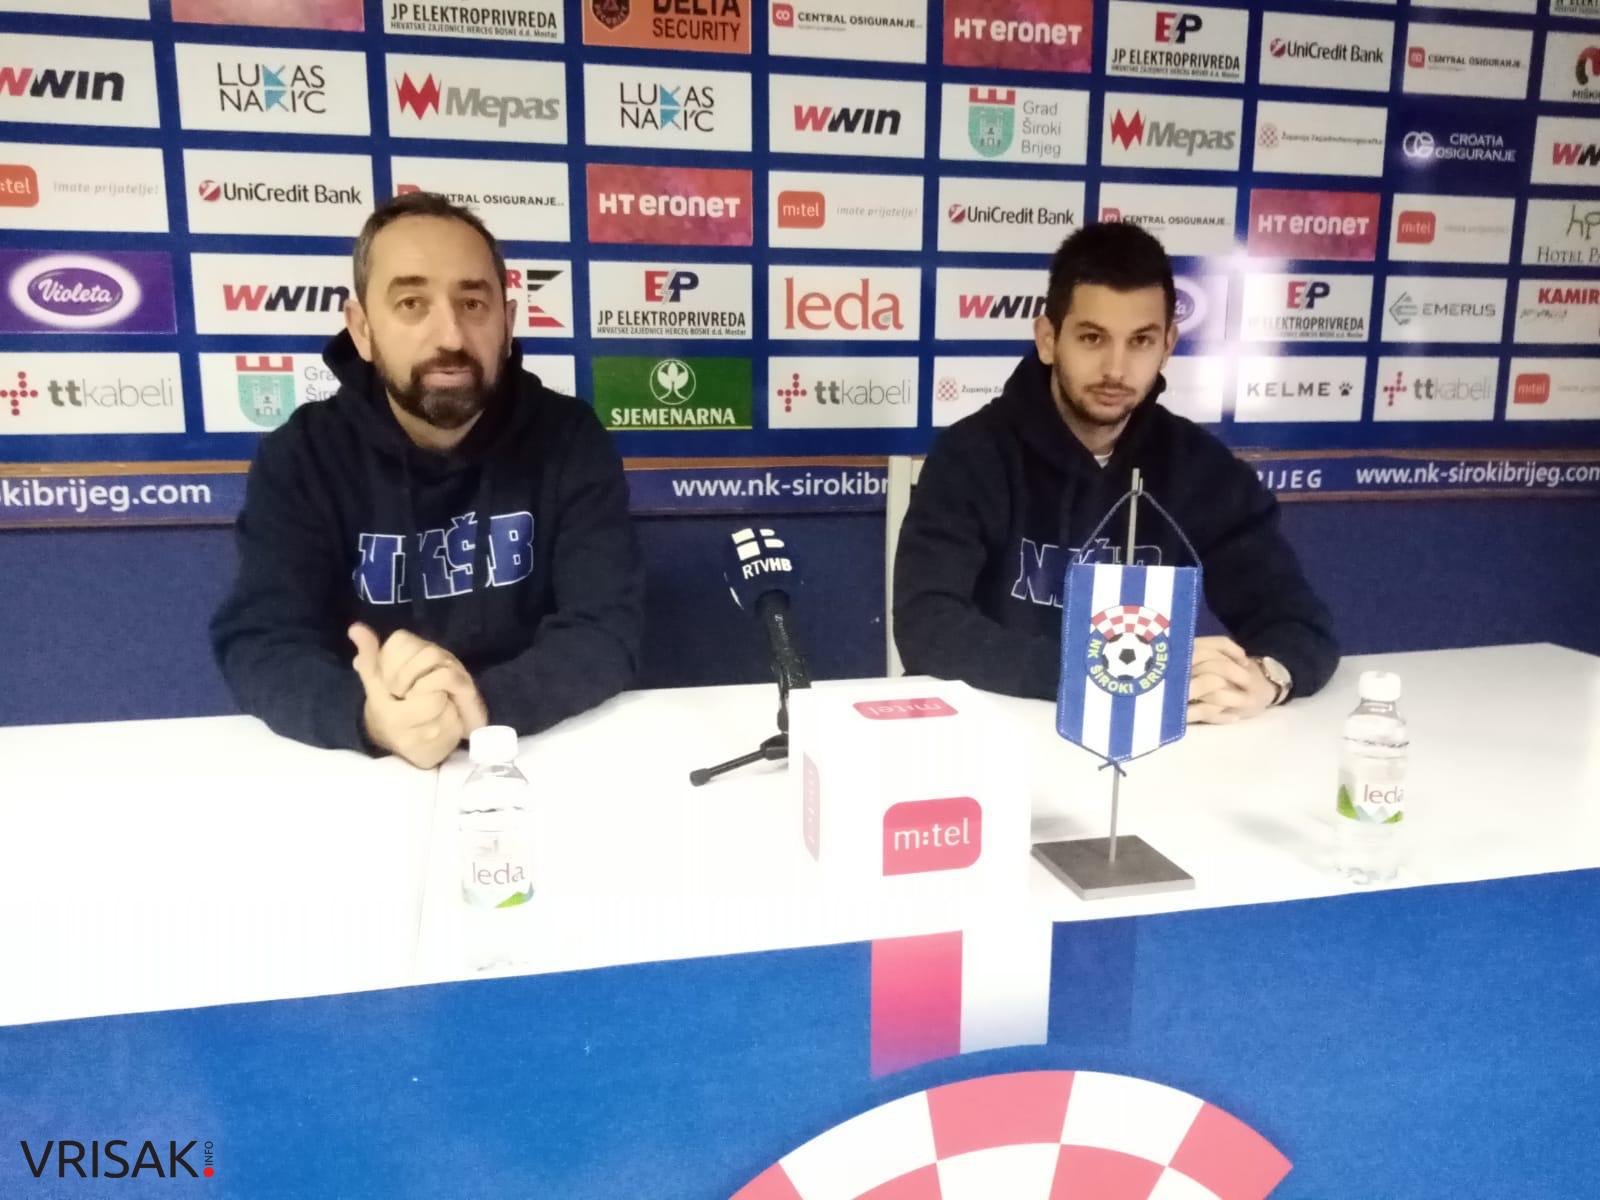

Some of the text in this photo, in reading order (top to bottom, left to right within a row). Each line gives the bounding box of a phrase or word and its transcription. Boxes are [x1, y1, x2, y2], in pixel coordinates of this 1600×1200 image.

[391, 3, 557, 29] JP ELEKTROPRIVREDA
[798, 12, 847, 24] CENTRAL
[850, 16, 916, 28] OSIGURANJE
[391, 21, 426, 31] HRVATSKE
[428, 22, 465, 33] ZAJEDNICE
[467, 25, 493, 35] HERCEG
[653, 18, 740, 41] SECURITY
[954, 17, 985, 40] HT
[1112, 48, 1240, 70] JP ELEKTROPRIVREDA
[1288, 41, 1383, 63] UniCredit Bank
[1428, 55, 1465, 65] CENTRAL
[446, 87, 560, 128] Mepas
[1023, 101, 1058, 116] Grad
[1022, 117, 1062, 135] Široki
[1021, 140, 1062, 158] Brijeg
[1146, 121, 1236, 156] Mepas
[1450, 133, 1504, 147] CROATIA
[1435, 147, 1517, 162] OSIGURANJE
[1552, 142, 1600, 166] WW
[223, 182, 362, 205] UniCredit Bank
[483, 195, 556, 206] OSIGURANJE
[599, 193, 635, 215] HT
[782, 202, 819, 217] m:tel
[968, 205, 1074, 225] UniCredit Bank
[1257, 215, 1286, 233] HT
[38, 278, 113, 304] Violeta
[784, 277, 905, 331] leda
[1422, 303, 1496, 317] EMERUS
[598, 310, 746, 327] JP ELEKTROPRIVREDA
[597, 326, 629, 335] HRVATSKE
[630, 327, 663, 336] ZAJEDNICE
[665, 327, 689, 336] HERCEG
[690, 327, 710, 336] BOSNE
[304, 366, 337, 381] Gra
[47, 378, 174, 407] ttkabeli
[814, 379, 911, 406] ttkabeli
[1247, 382, 1330, 398] KELME
[1413, 377, 1491, 401] ttkabeli
[611, 407, 736, 426] SJEMENARNA
[0, 479, 211, 511] kibrijeg.com
[742, 557, 793, 580] RTVHB
[1087, 639, 1102, 658] NK
[1139, 642, 1168, 689] BRIJEG
[894, 817, 970, 851] m:tel
[472, 862, 526, 885] leda
